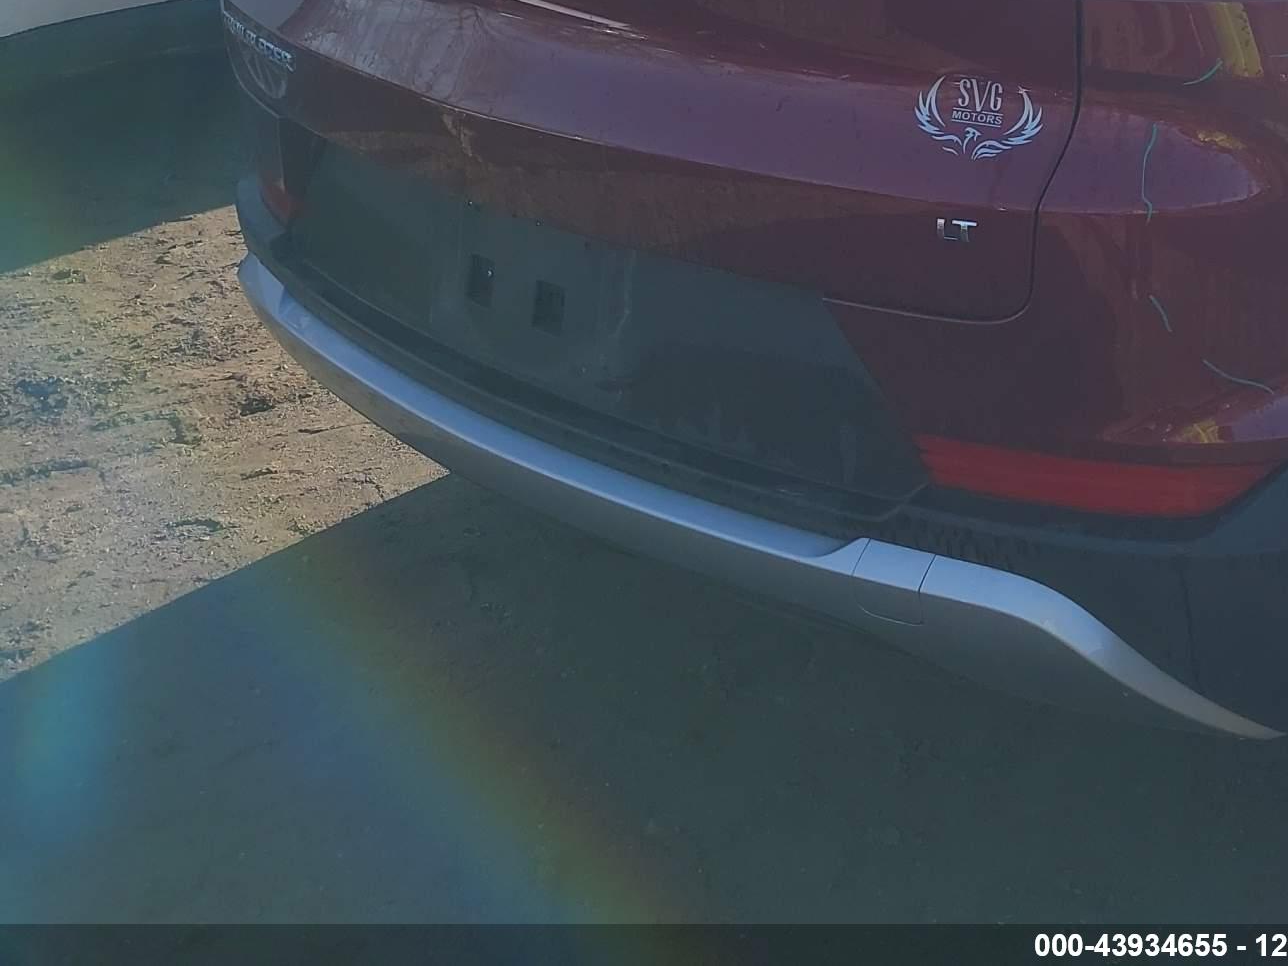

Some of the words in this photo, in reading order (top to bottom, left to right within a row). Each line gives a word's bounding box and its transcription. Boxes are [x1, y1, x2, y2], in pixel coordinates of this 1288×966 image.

[957, 78, 1004, 112] SVG
[951, 110, 1003, 125] MOTORS
[936, 218, 978, 242] LT
